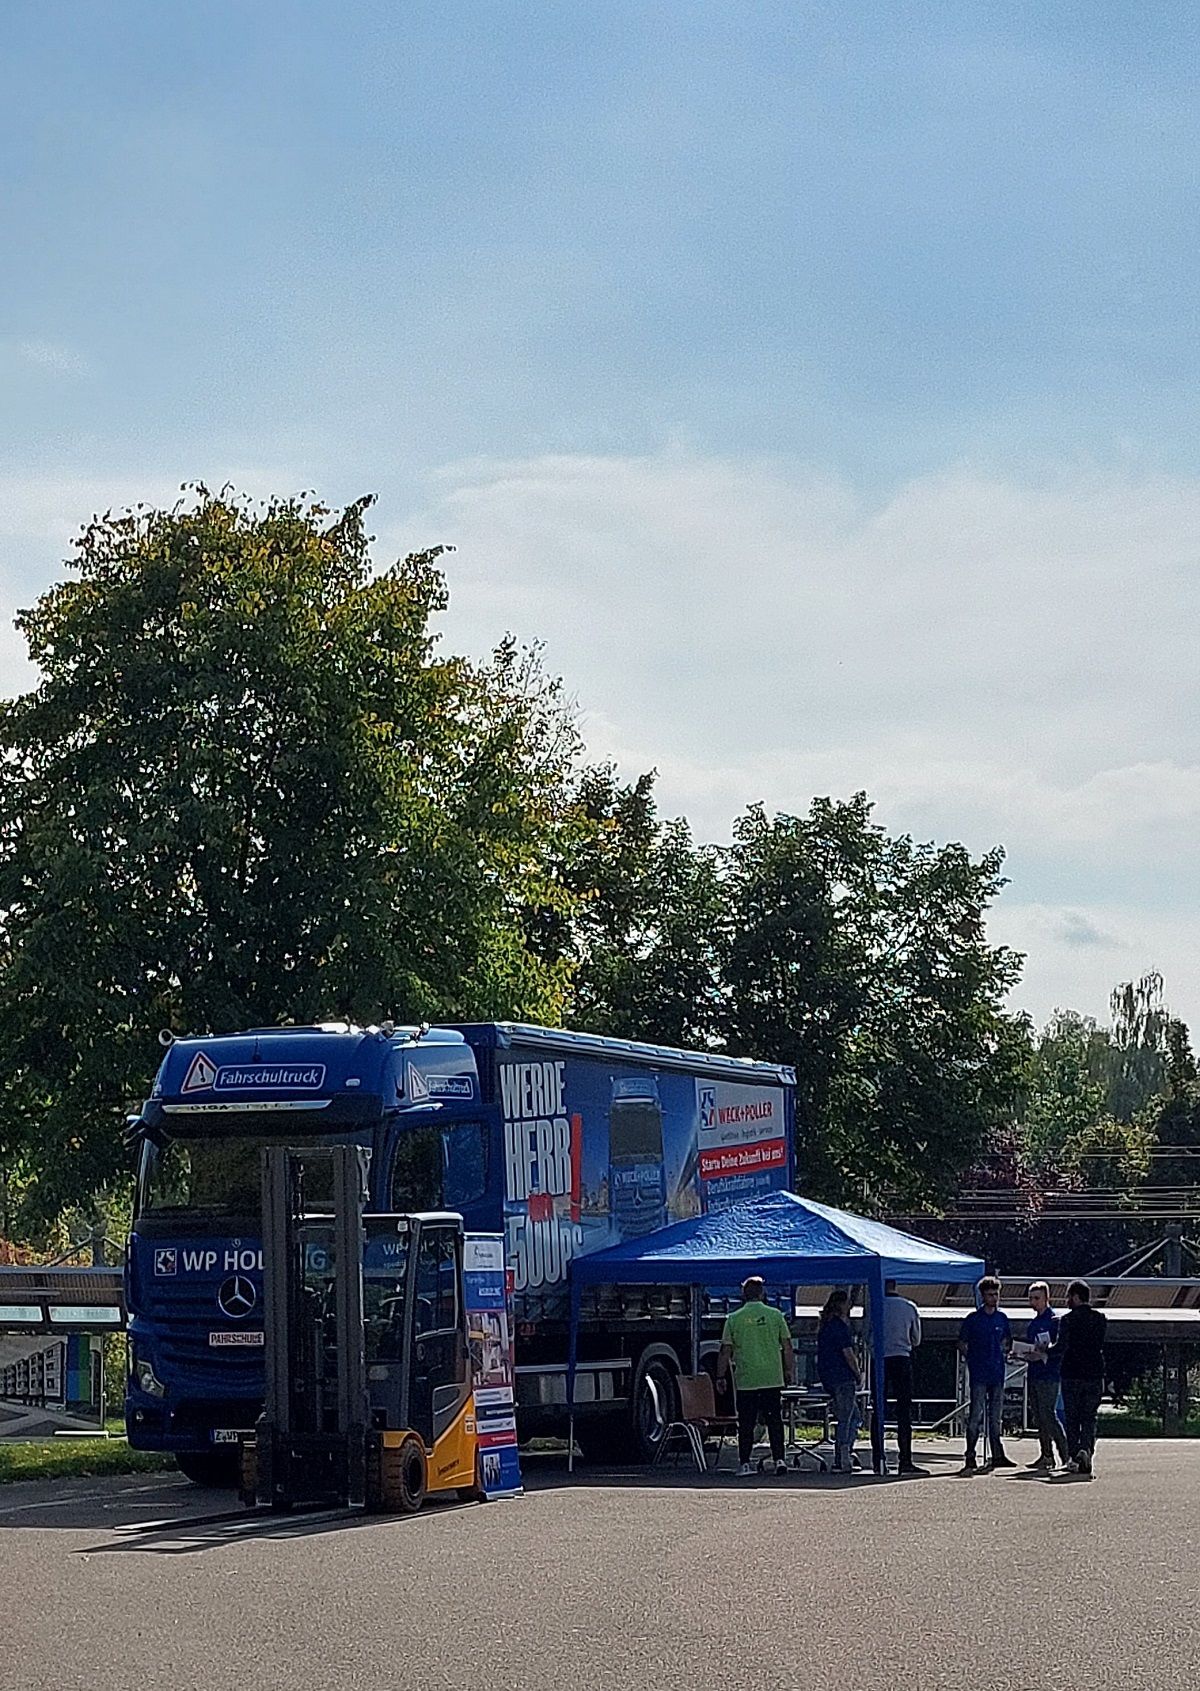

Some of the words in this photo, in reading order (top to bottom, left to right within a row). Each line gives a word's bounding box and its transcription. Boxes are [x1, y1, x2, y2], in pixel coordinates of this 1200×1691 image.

[220, 1068, 319, 1085] Fahrschultruck
[500, 1061, 567, 1119] WERDE
[718, 1101, 773, 1125] WECK+POLLER
[183, 1250, 217, 1271] WP
